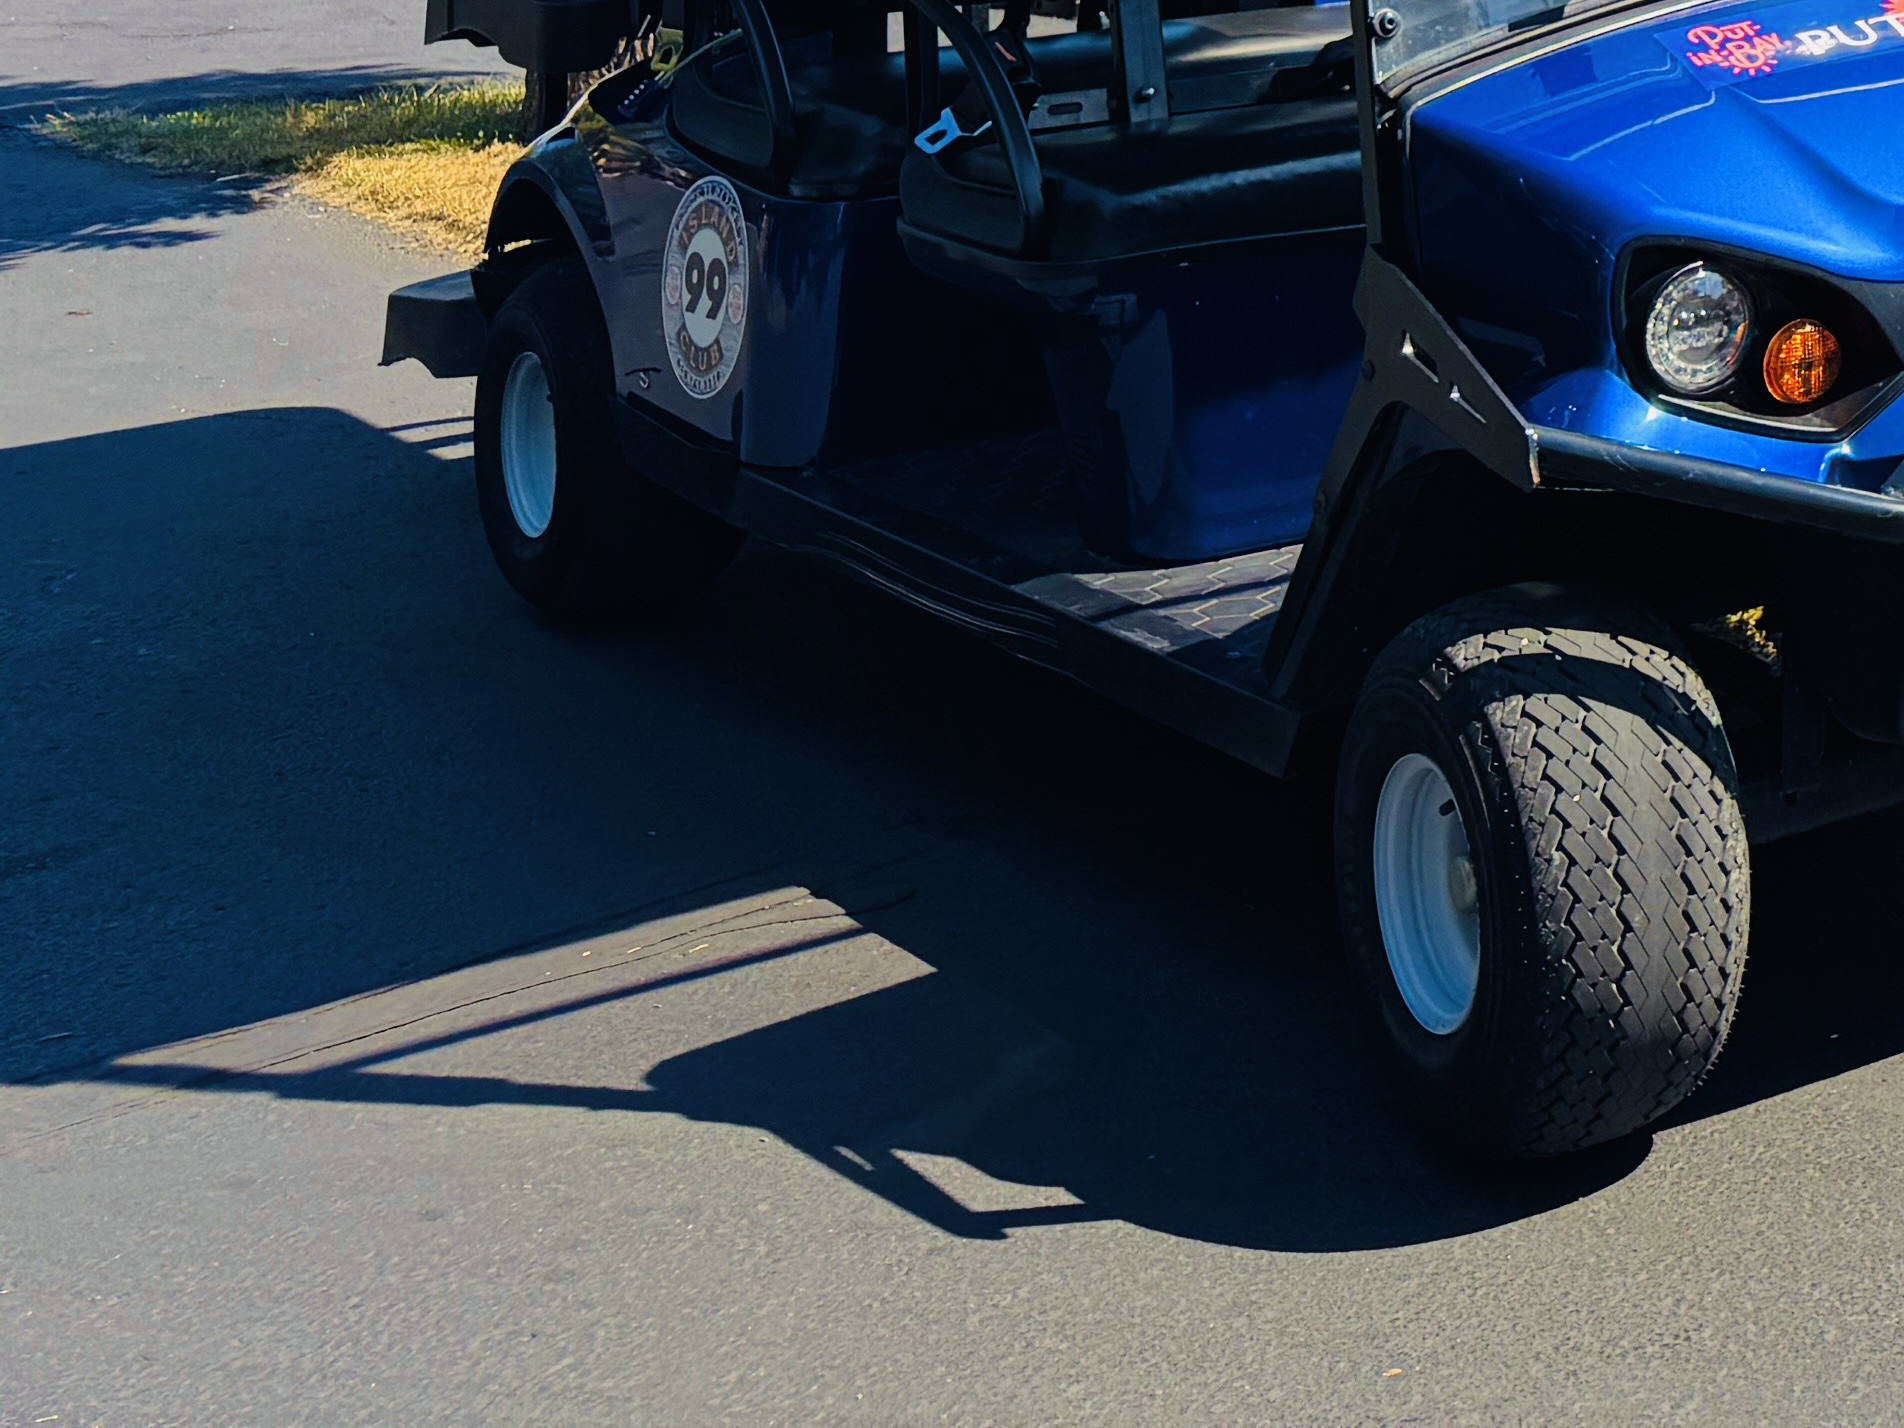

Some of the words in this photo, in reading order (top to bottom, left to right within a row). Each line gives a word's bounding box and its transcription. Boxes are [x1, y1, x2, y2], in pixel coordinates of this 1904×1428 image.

[681, 204, 737, 262] ISLAND
[685, 251, 727, 320] 99
[680, 330, 720, 371] CLUB
